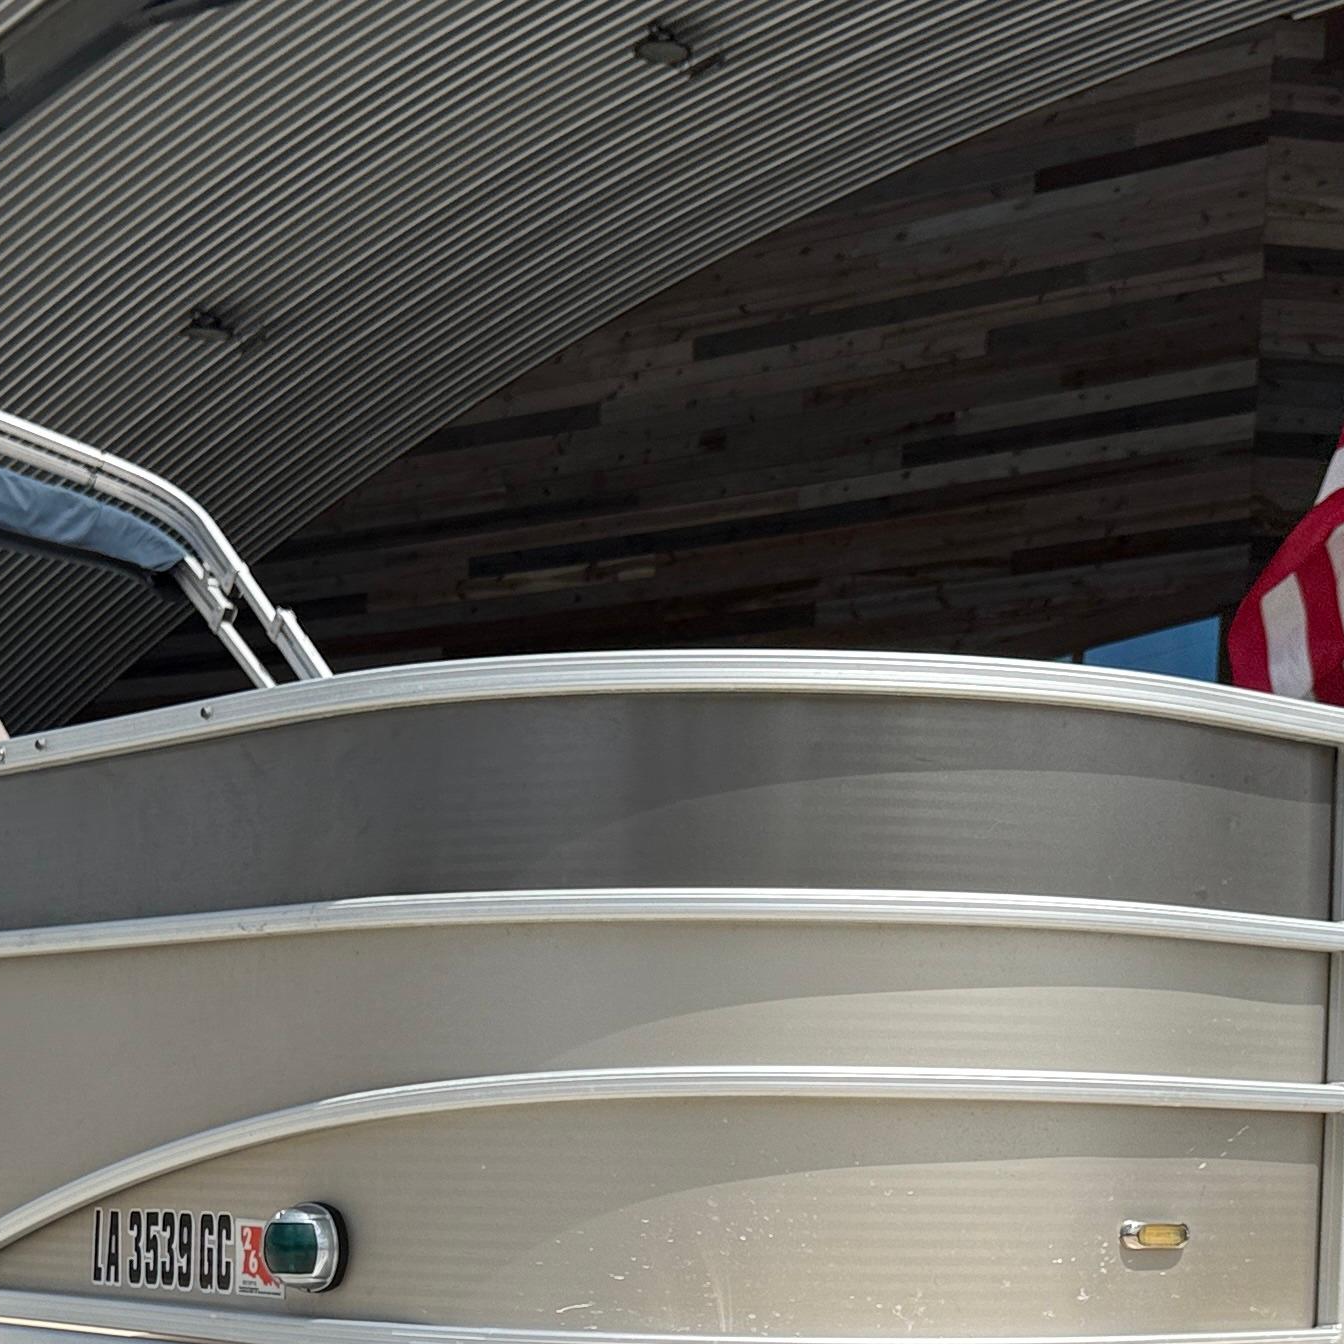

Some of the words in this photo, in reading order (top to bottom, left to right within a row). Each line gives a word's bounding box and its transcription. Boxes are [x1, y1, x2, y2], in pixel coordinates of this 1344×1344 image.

[93, 1209, 120, 1284] LA
[128, 1210, 194, 1287] 3539
[200, 1213, 232, 1292] GC
